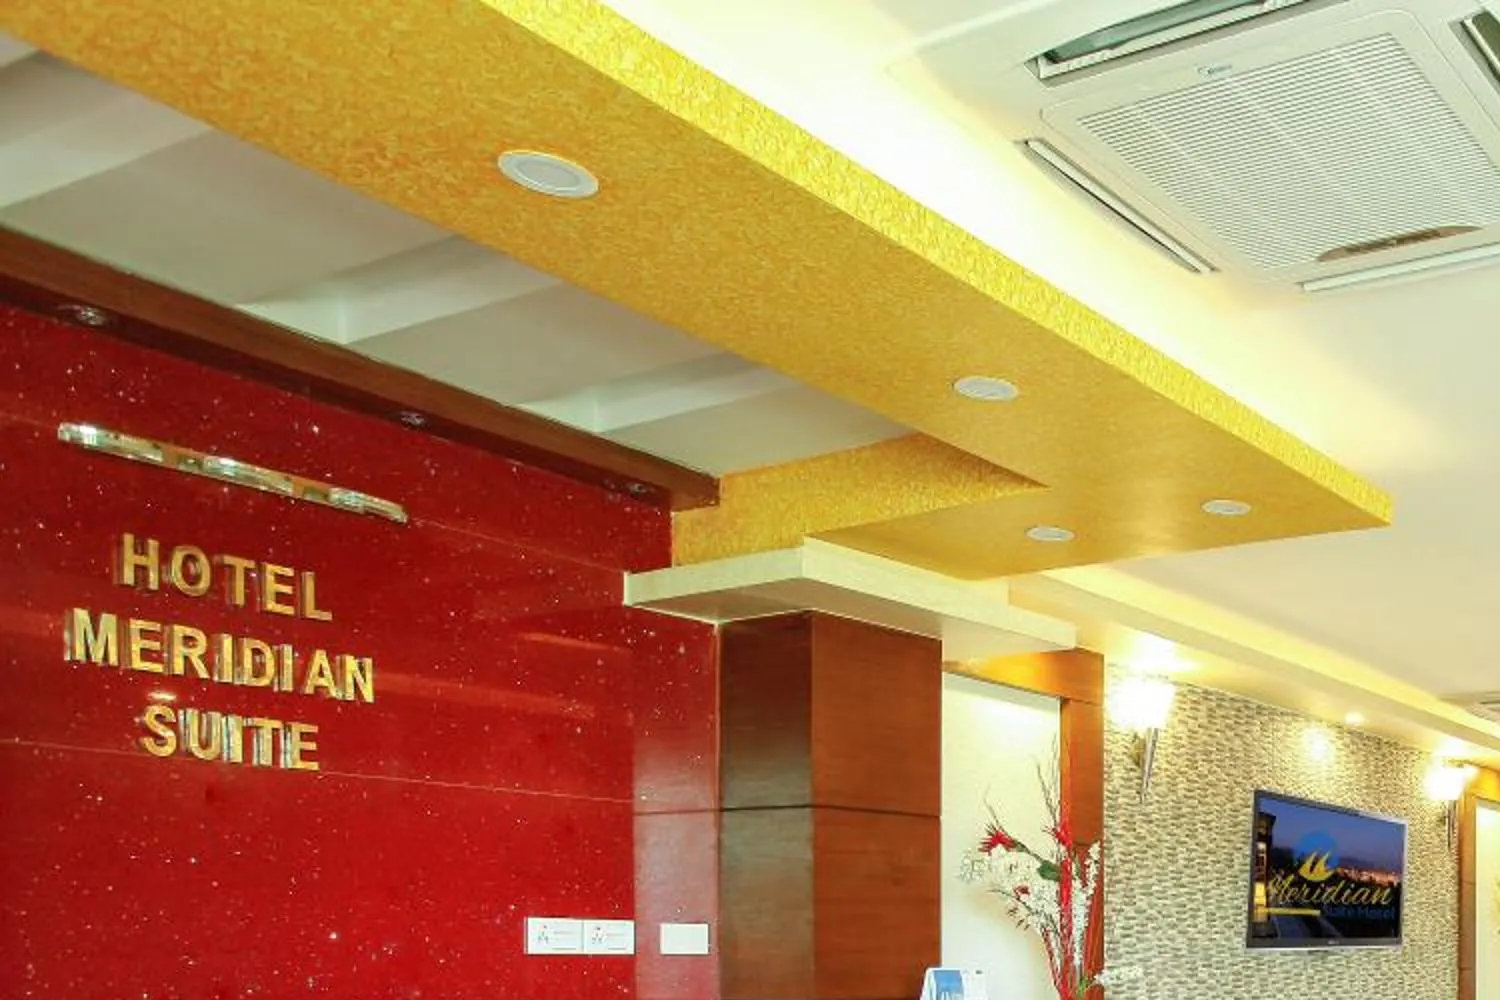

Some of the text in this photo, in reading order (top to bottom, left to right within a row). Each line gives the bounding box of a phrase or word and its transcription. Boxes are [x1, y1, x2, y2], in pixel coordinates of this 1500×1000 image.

[114, 532, 333, 622] HOTEL
[64, 607, 375, 704] MERIDIAN
[139, 703, 321, 772] SUITE
[1267, 870, 1394, 906] Meridian
